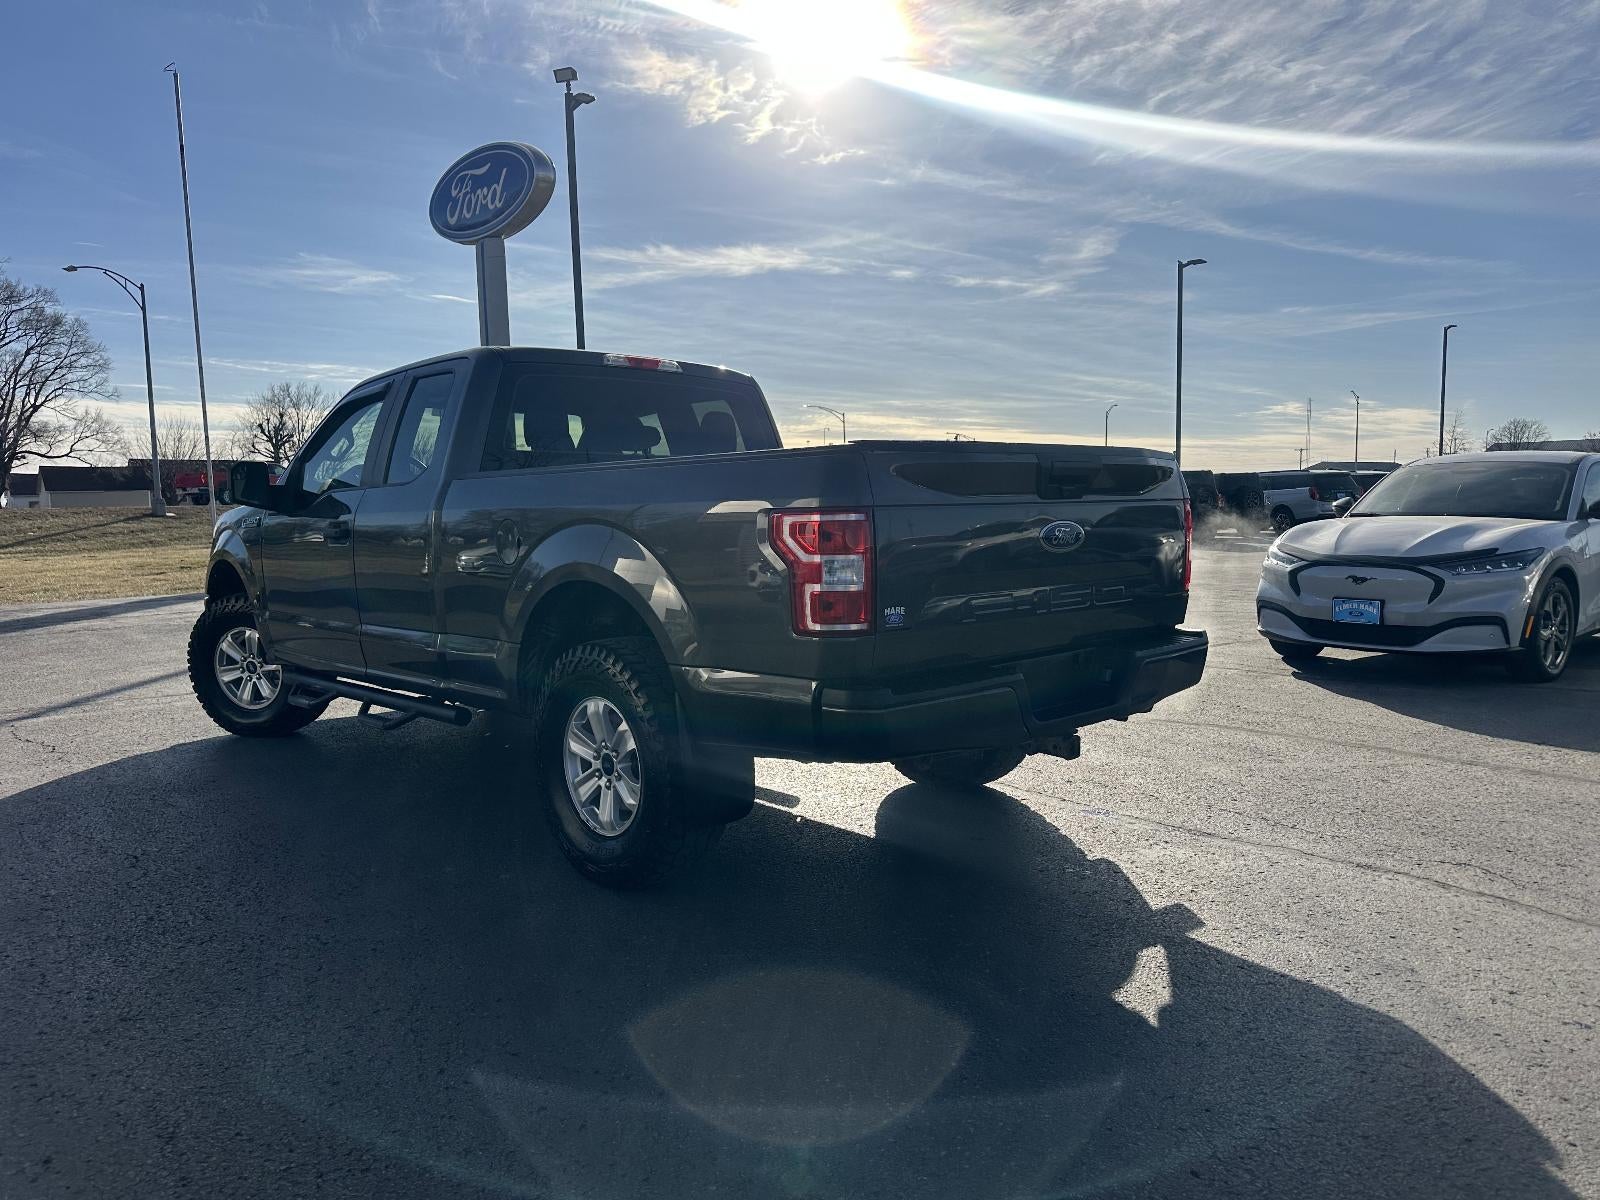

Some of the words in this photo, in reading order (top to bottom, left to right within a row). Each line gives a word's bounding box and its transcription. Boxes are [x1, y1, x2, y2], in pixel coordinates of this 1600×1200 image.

[447, 162, 508, 225] Ford
[1051, 527, 1077, 545] Ford
[884, 606, 906, 616] HARE
[1335, 602, 1358, 612] ELMER
[1359, 603, 1377, 615] HARE
